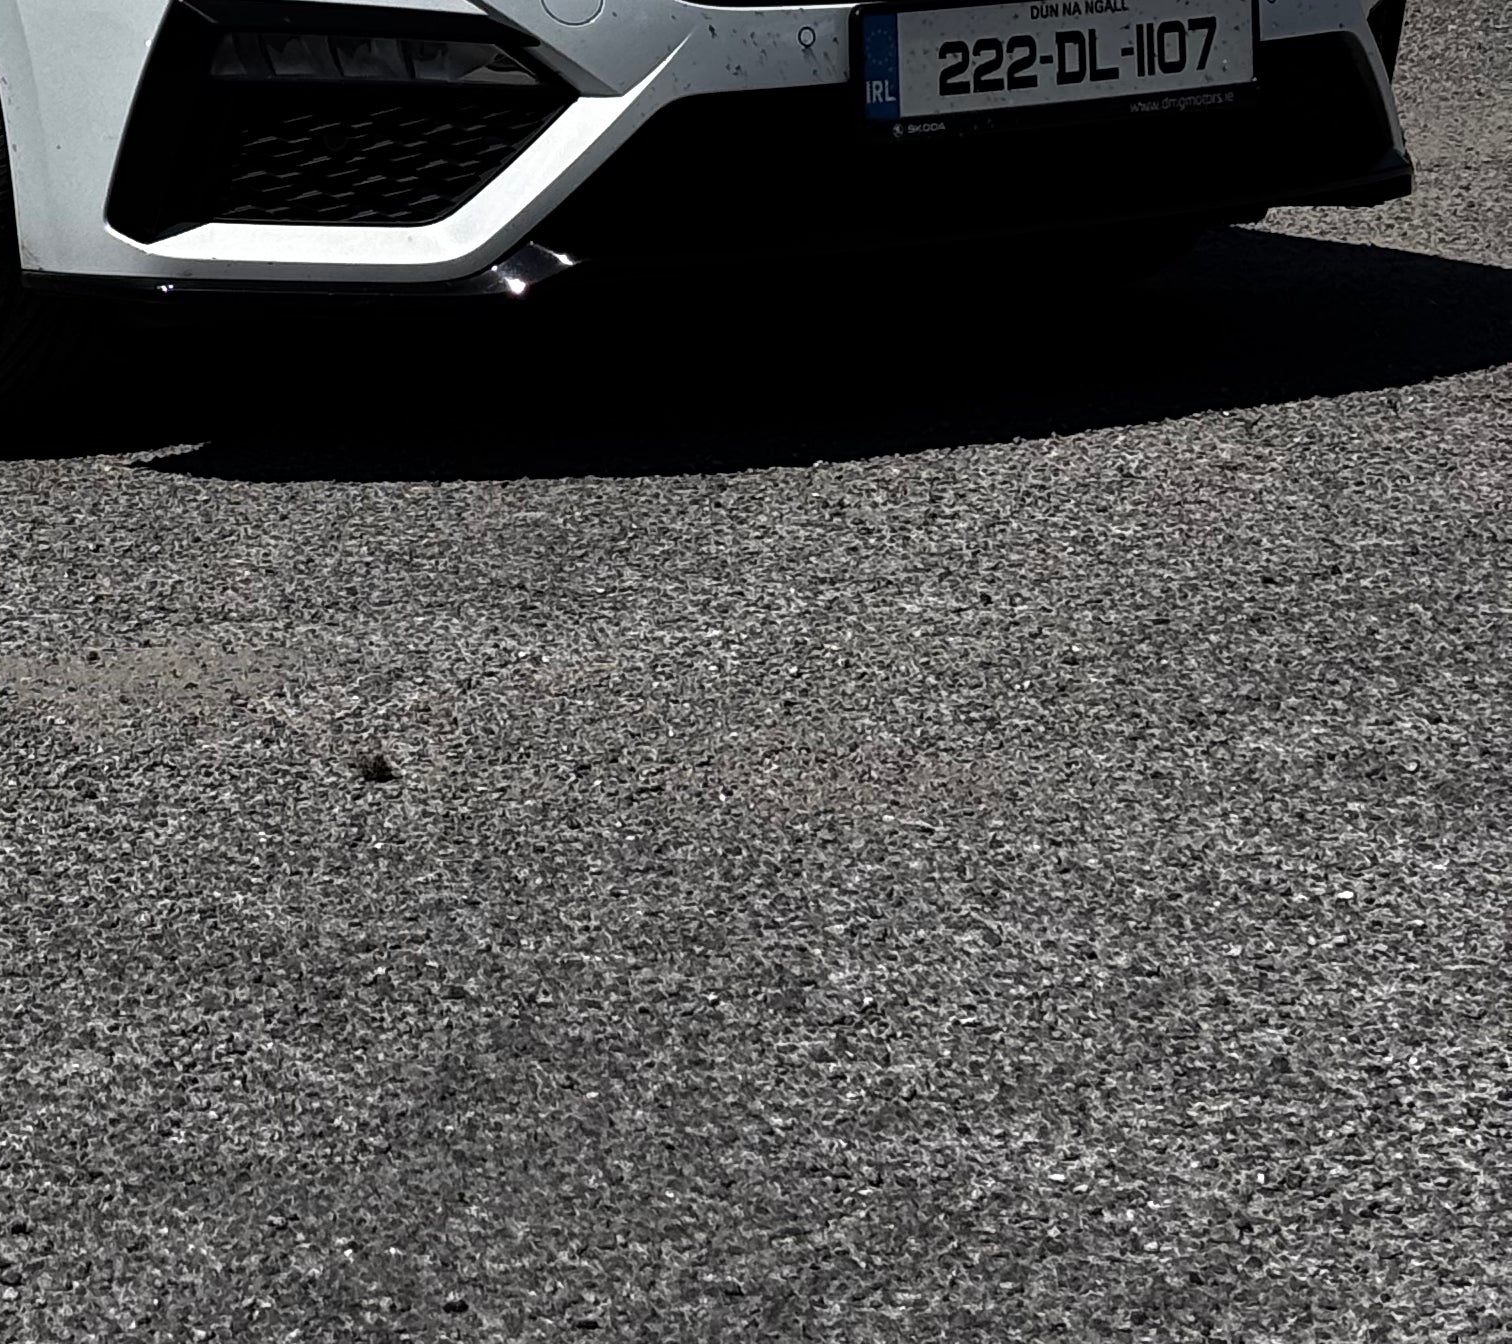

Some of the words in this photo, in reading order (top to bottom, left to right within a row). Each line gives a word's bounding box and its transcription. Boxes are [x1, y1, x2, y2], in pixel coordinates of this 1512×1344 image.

[1062, 1, 1082, 16] NA
[938, 16, 1217, 96] 222-DL-1107
[865, 79, 897, 104] IRL
